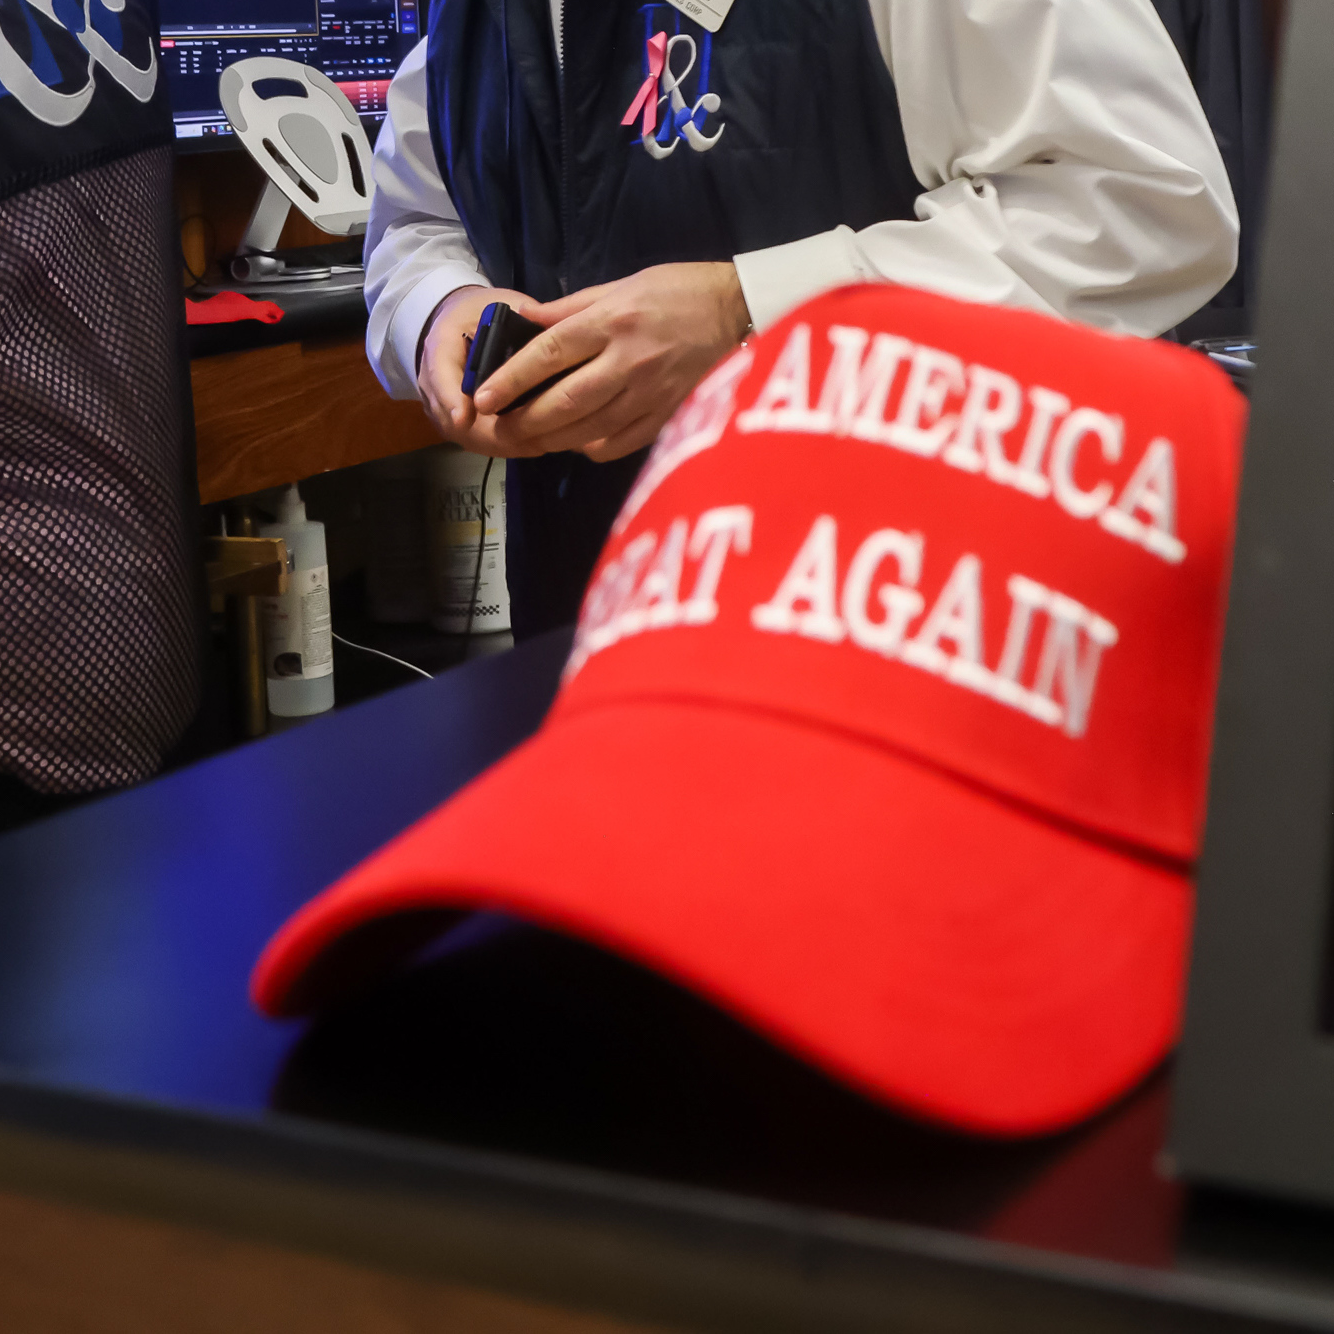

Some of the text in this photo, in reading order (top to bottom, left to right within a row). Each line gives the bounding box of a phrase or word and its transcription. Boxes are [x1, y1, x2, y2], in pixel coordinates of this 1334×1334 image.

[686, 1, 703, 15] CORP
[736, 322, 1186, 565] AMERICA
[751, 515, 1118, 737] AGAIN
